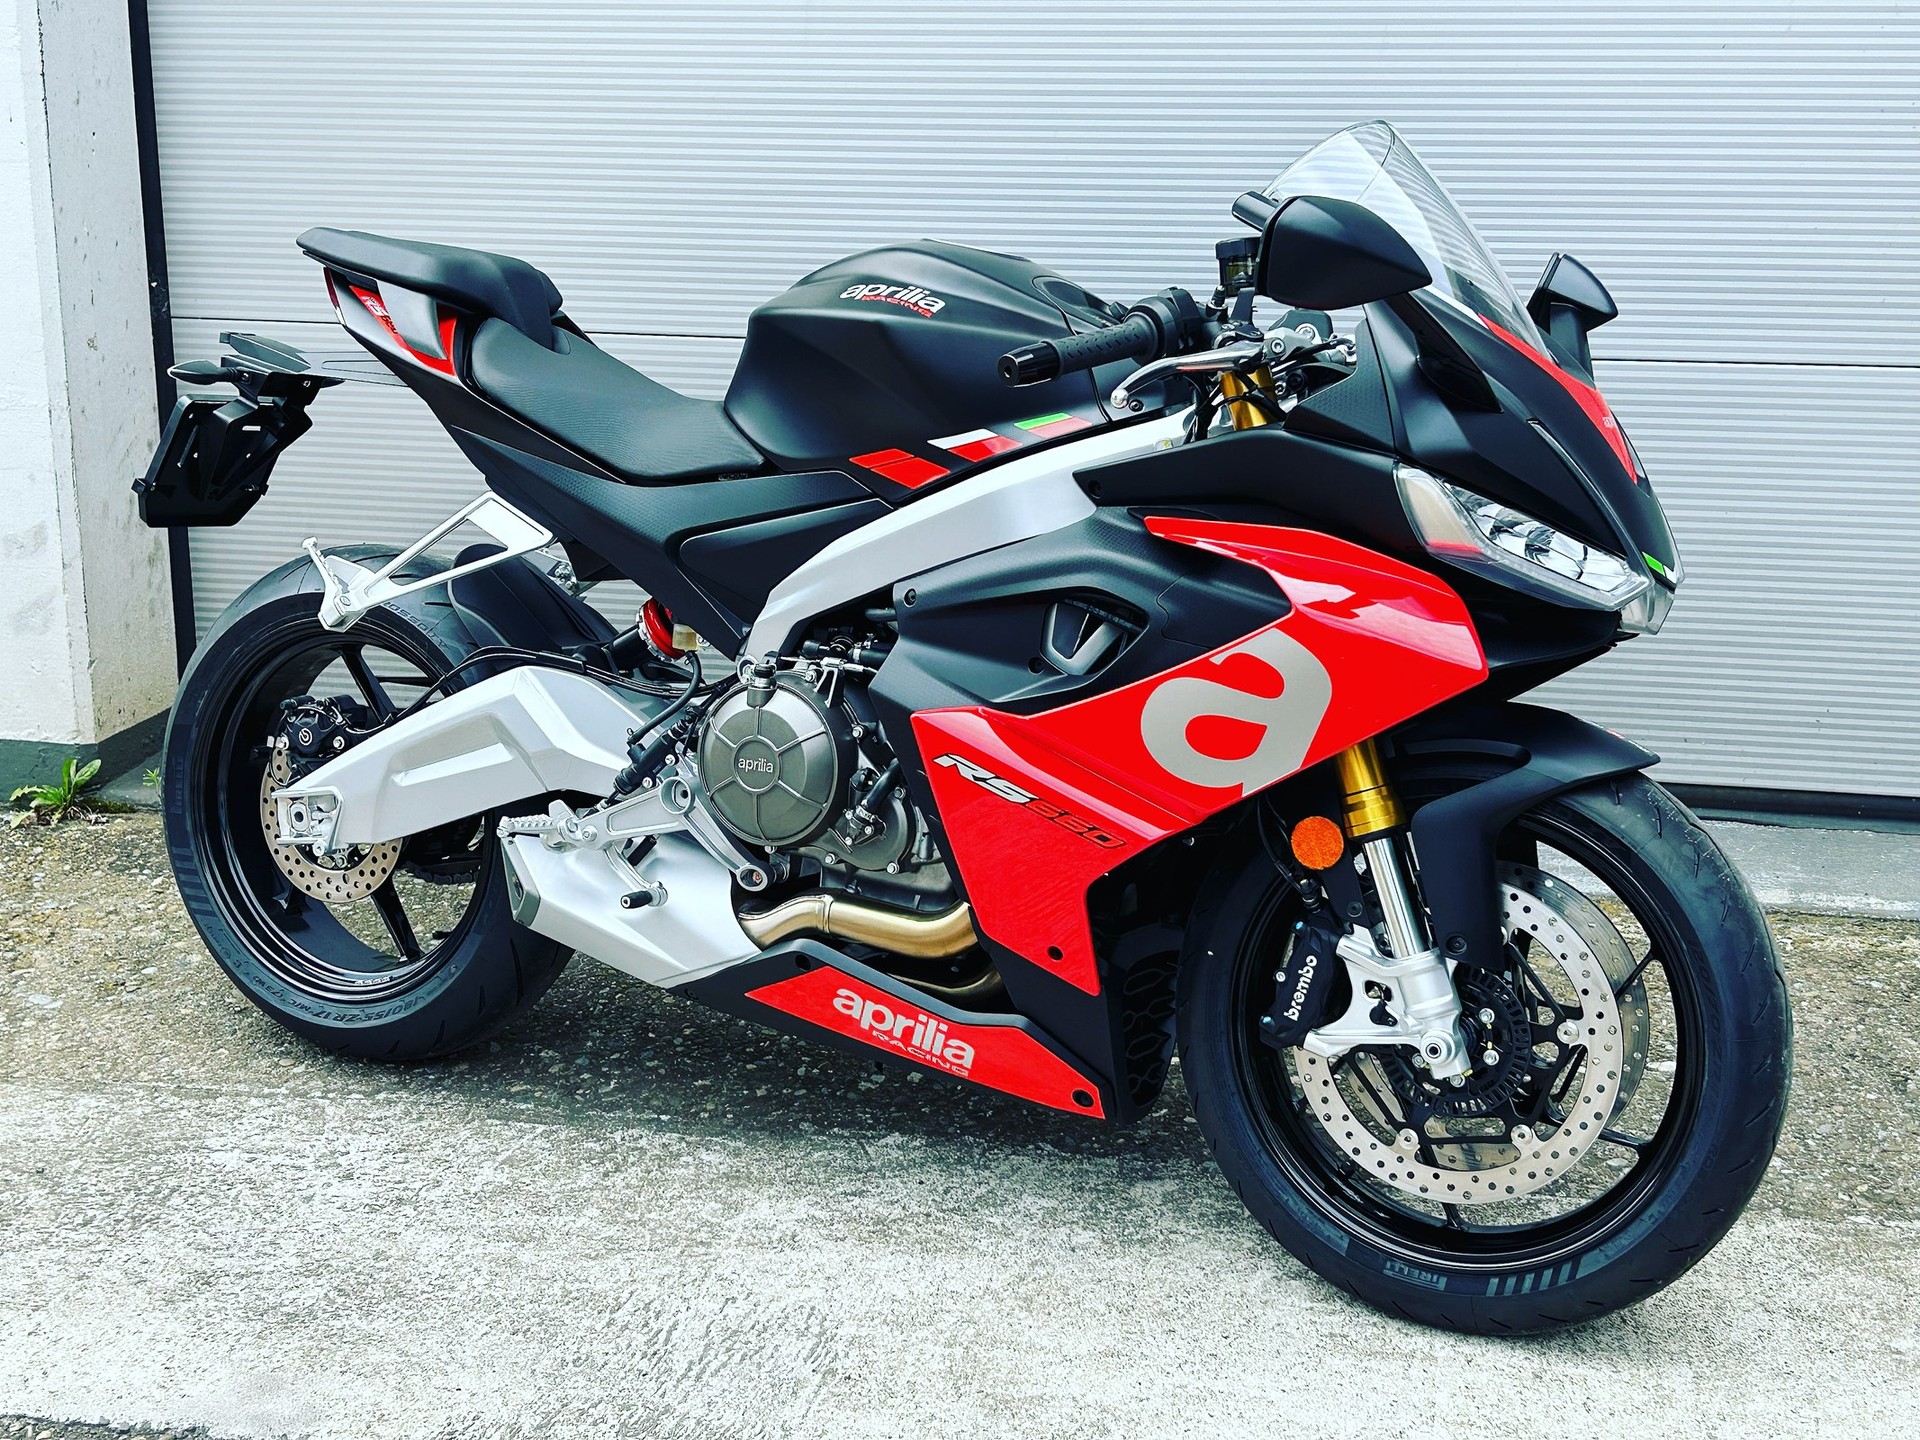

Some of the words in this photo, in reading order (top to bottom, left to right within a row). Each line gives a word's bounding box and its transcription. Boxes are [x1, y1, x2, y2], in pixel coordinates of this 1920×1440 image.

[840, 284, 946, 314] aprilia
[738, 757, 774, 773] aprilia
[1283, 955, 1318, 1021] brembo
[832, 987, 976, 1070] aprilia
[872, 1029, 969, 1078] RACING
[1382, 1260, 1448, 1292] PIRELLI
